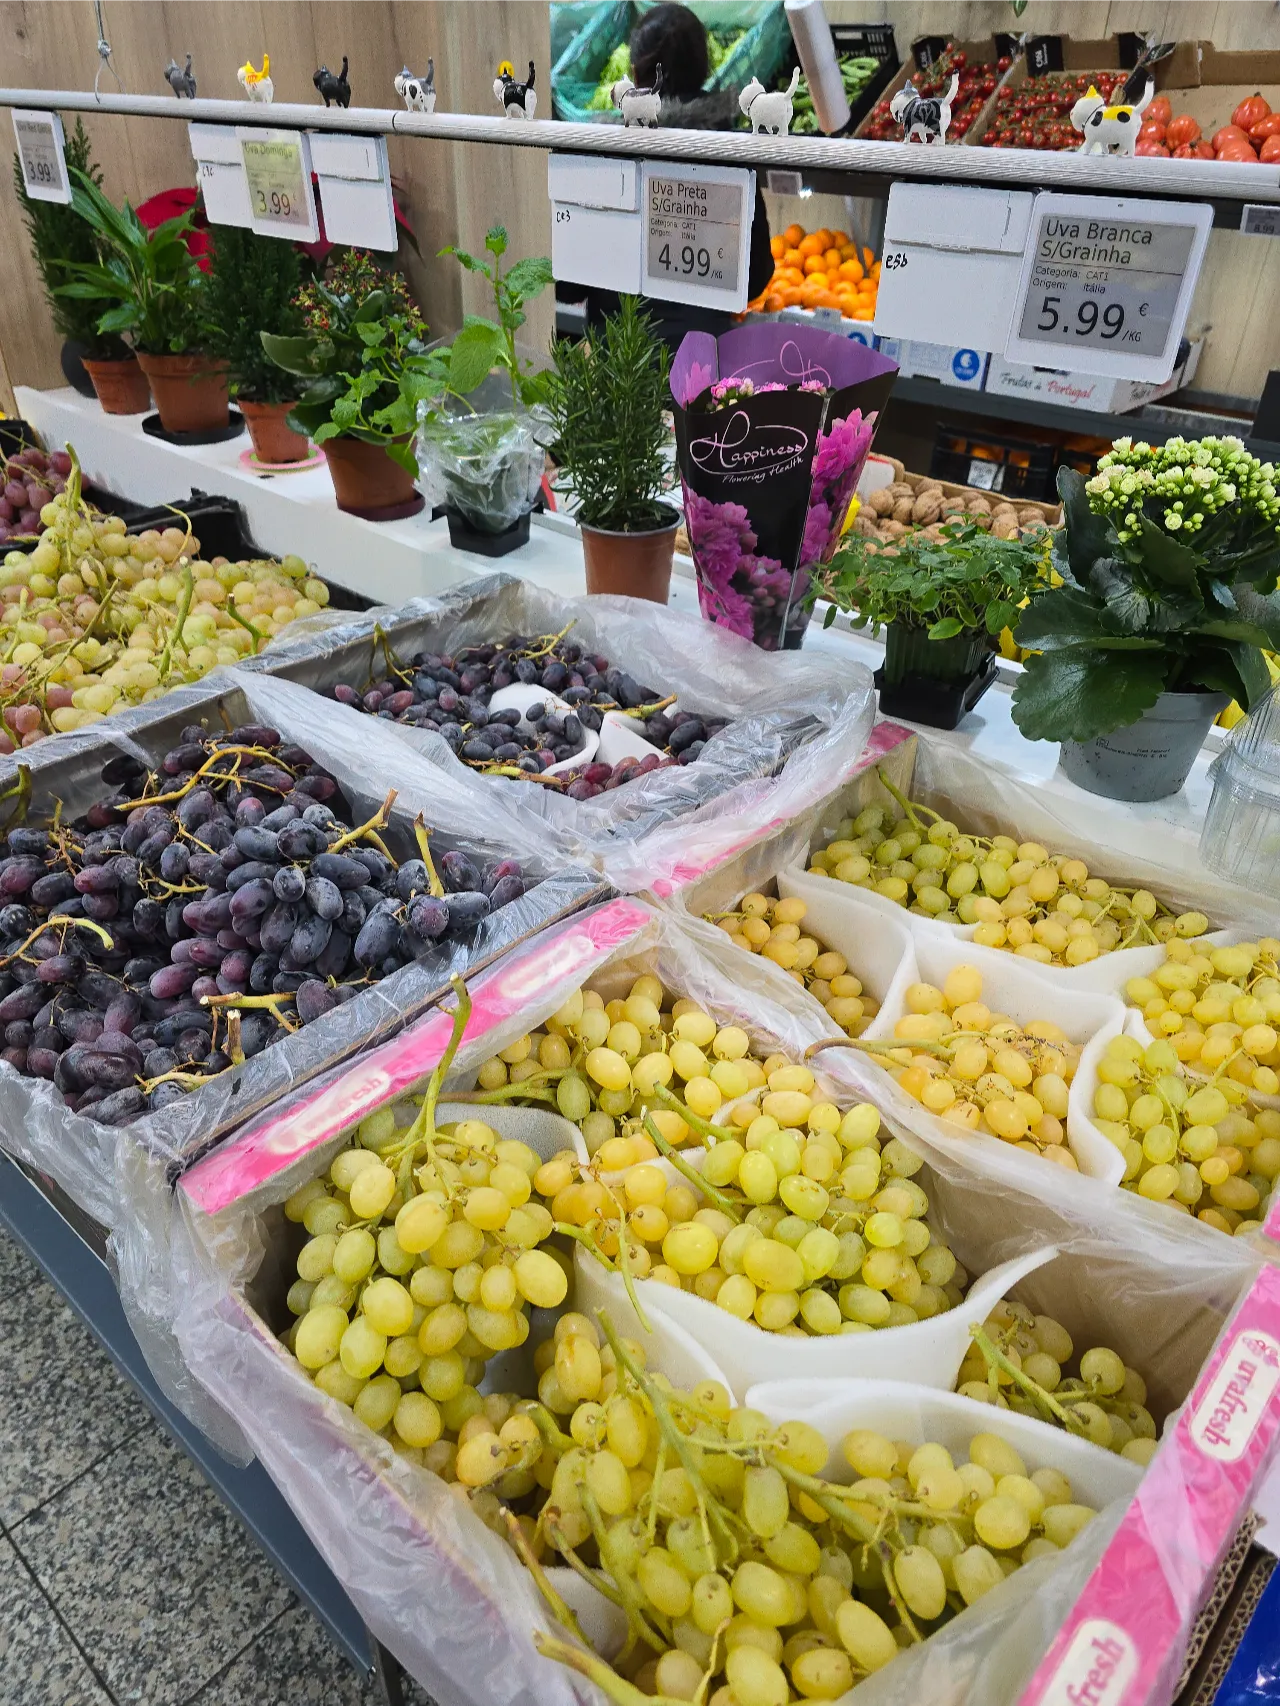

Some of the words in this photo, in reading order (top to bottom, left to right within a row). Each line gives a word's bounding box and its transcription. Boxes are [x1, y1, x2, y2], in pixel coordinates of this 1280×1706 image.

[28, 161, 51, 182] 3.99
[257, 190, 291, 216] 3.99
[652, 181, 673, 196] Uva
[677, 183, 707, 200] Preta
[652, 197, 707, 217] S/Grainha
[1046, 219, 1080, 238] Uva
[1086, 222, 1153, 245] Branca
[659, 243, 711, 277] 4.99
[717, 247, 724, 259] €
[1040, 240, 1132, 264] S/Grainha
[1032, 277, 1068, 291] Origem:
[1035, 265, 1081, 279] Categoria:
[1085, 270, 1109, 282] CAT1
[1037, 296, 1125, 339] 5.99
[1138, 302, 1149, 317] €
[1121, 329, 1142, 343] /KG
[1047, 380, 1096, 404] Portugal
[690, 410, 804, 469] Happiness
[722, 473, 766, 484] Flowering
[769, 456, 804, 477] Health
[1200, 1359, 1258, 1446] uvafresh
[1066, 1636, 1125, 1706] fresh
